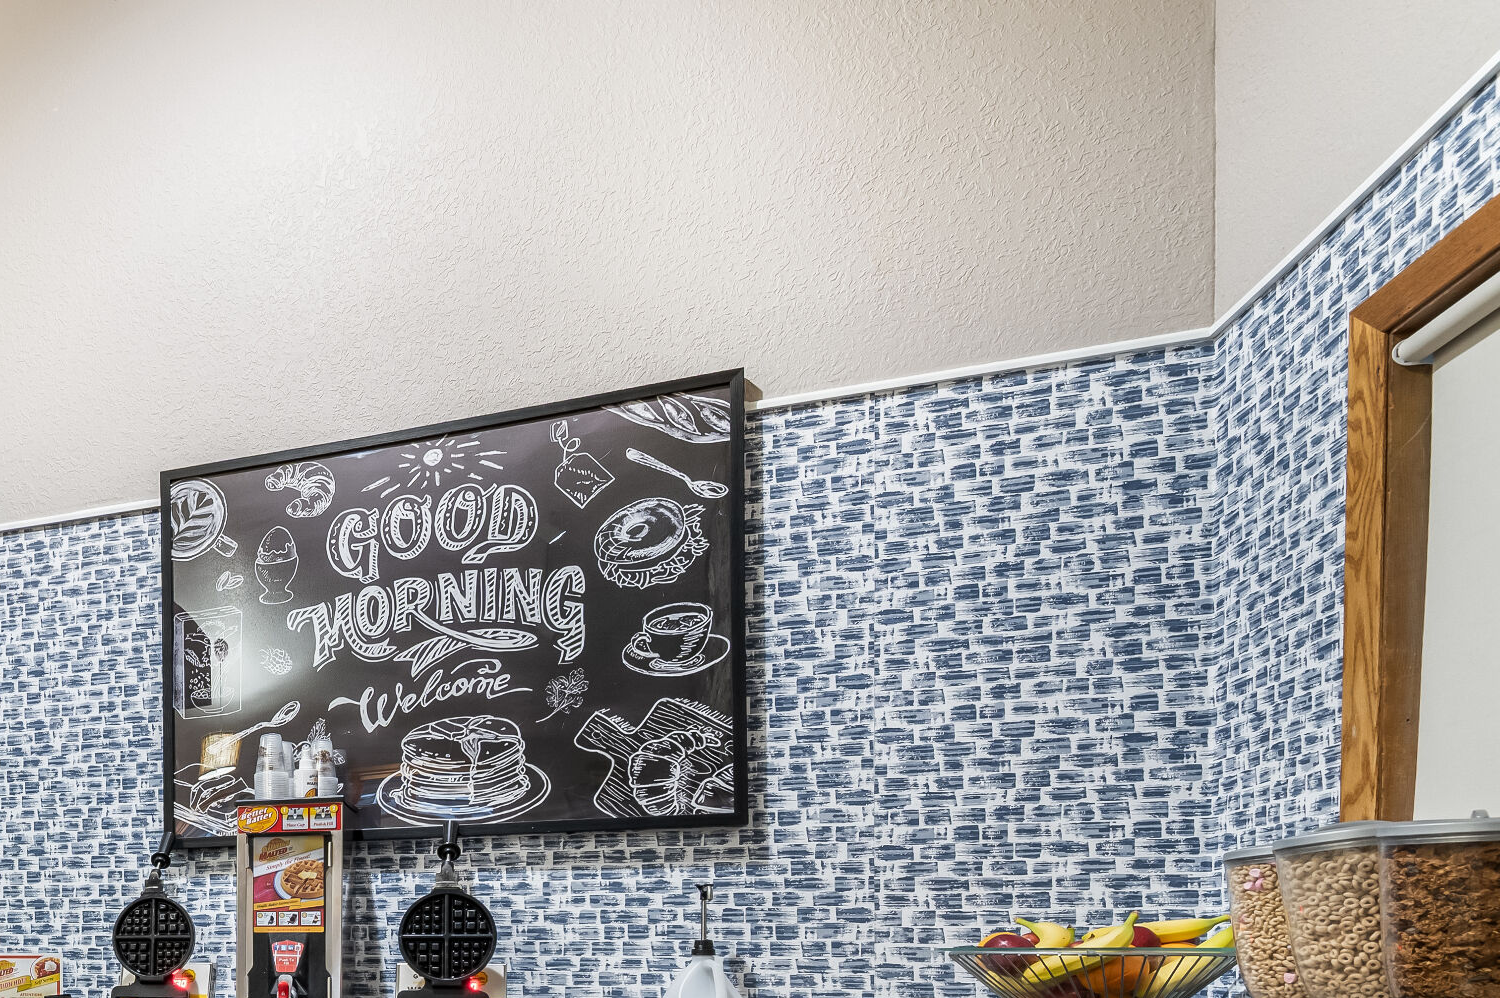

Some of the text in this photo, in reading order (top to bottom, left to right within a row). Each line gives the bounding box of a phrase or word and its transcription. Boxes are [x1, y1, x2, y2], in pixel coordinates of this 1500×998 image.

[327, 483, 539, 584] GOOD
[286, 565, 586, 681] MORNING
[328, 659, 533, 733] Welcome
[241, 807, 268, 820] Better
[246, 812, 273, 825] Batter
[259, 847, 288, 861] MALTED
